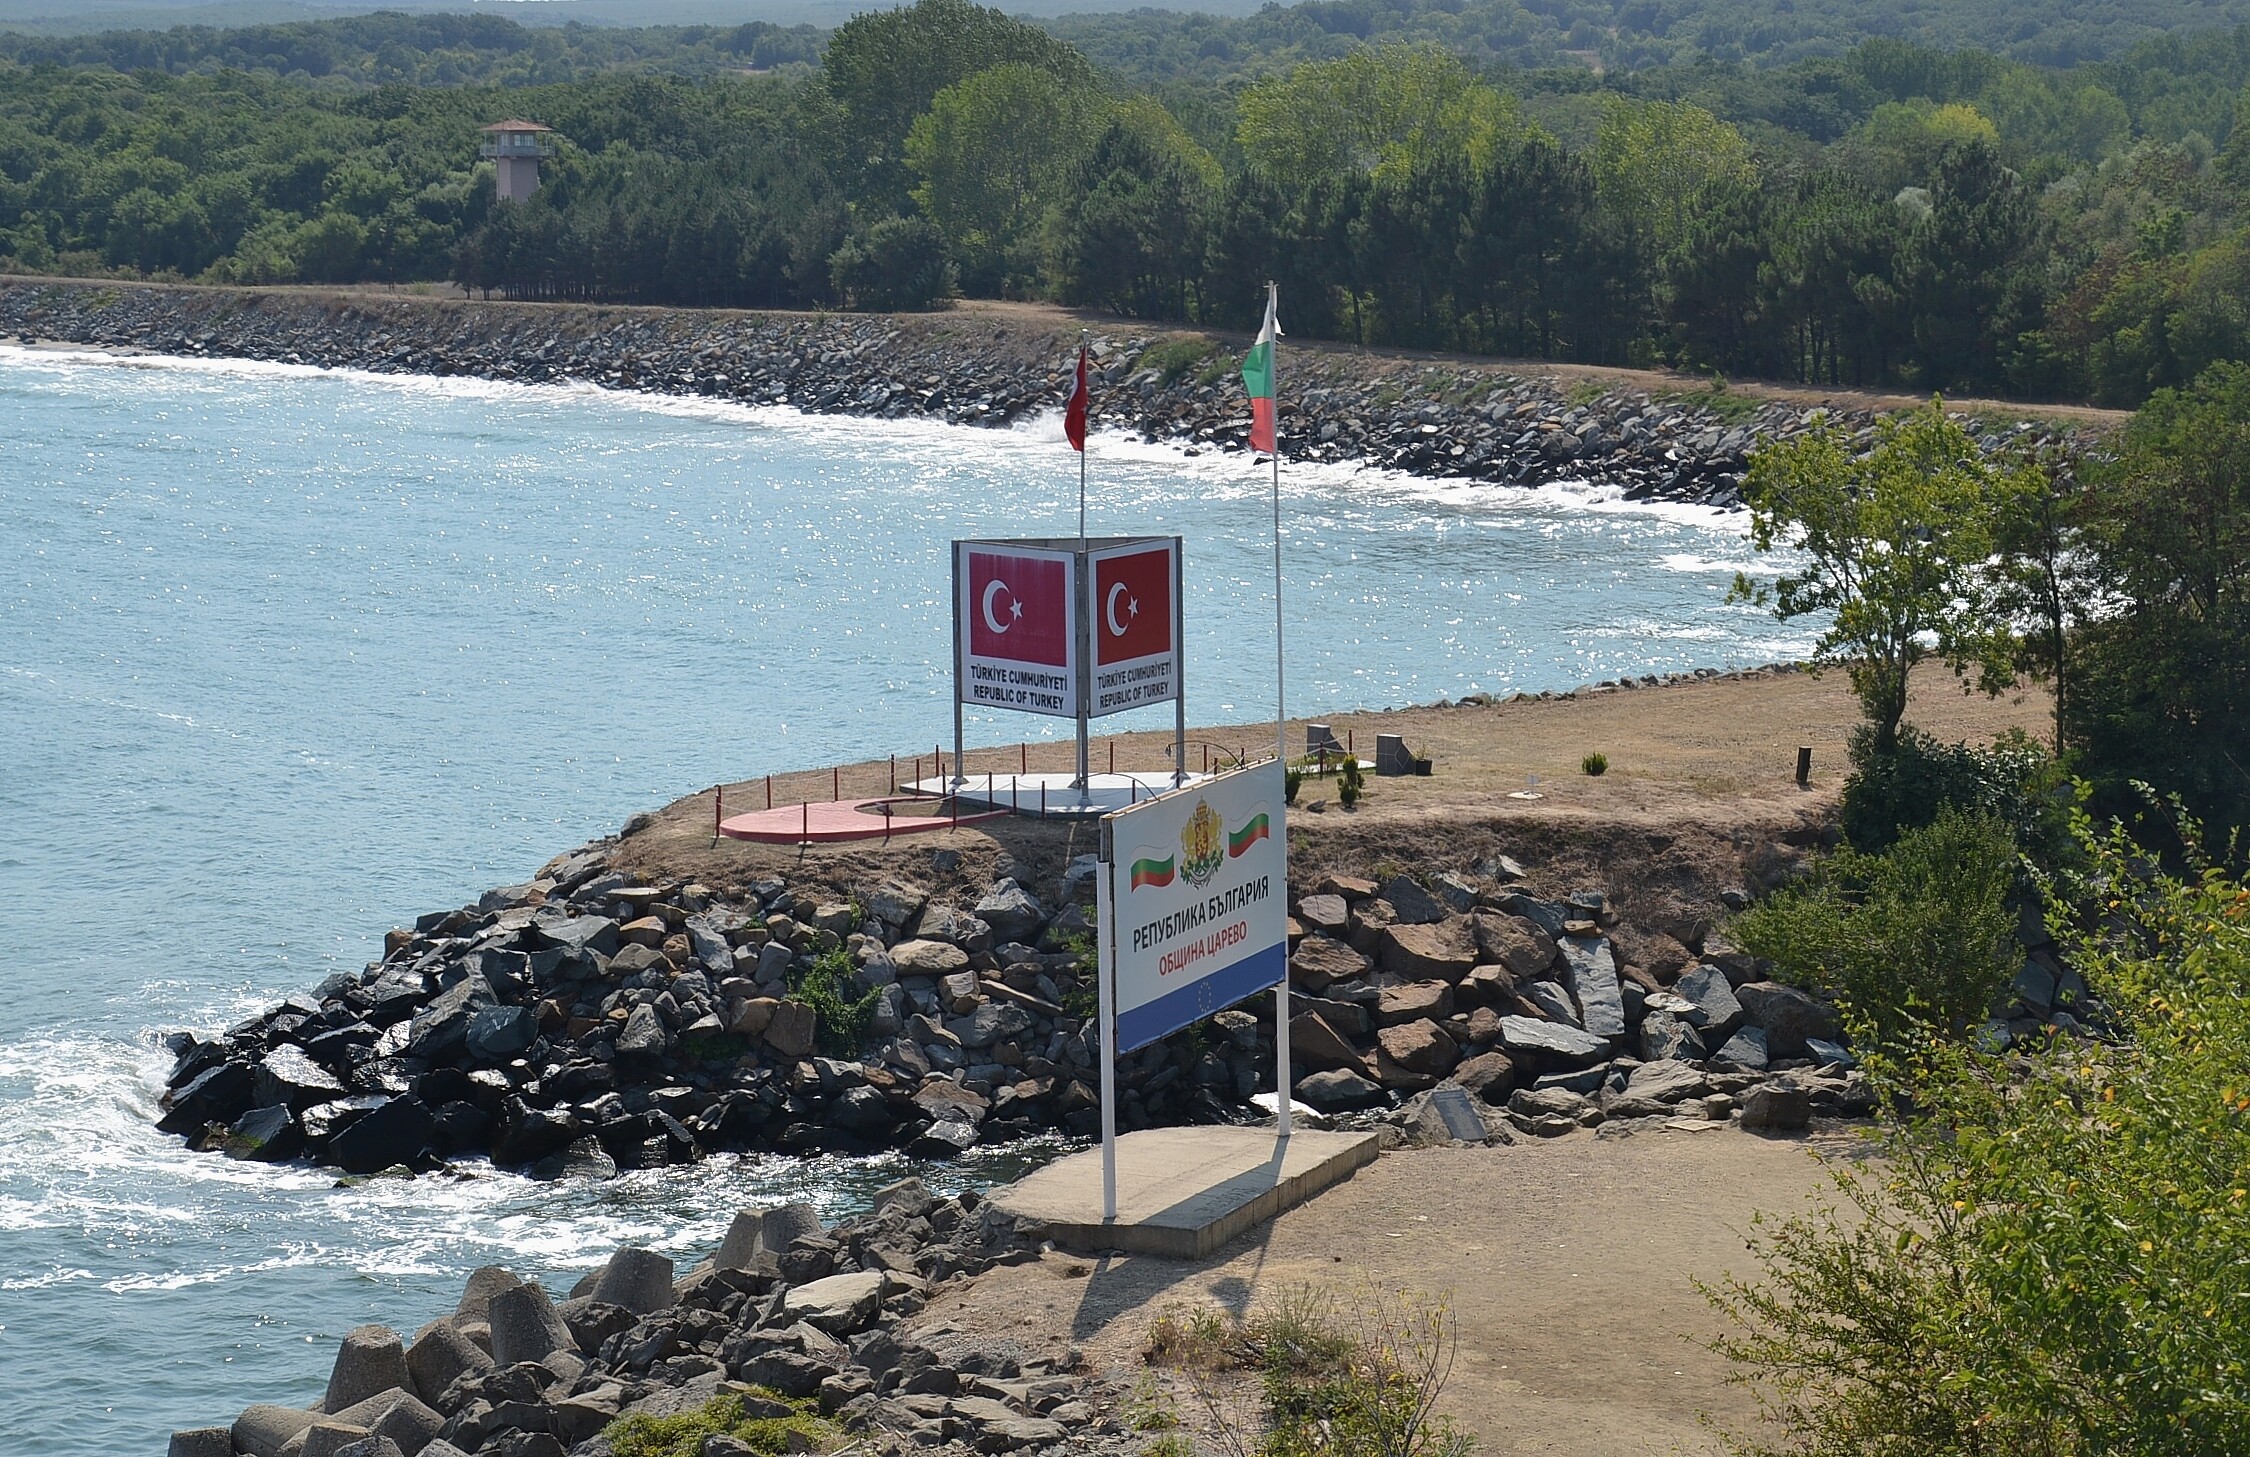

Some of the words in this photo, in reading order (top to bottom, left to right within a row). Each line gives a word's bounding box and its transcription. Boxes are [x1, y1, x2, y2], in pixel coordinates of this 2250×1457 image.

[970, 663, 1007, 683] TÜRKİYE
[1008, 670, 1068, 692] CUMHURİYETİ
[1097, 669, 1127, 690] TÜRKİYE
[1127, 658, 1172, 683] CUMHURİYETİ
[973, 684, 1014, 703] REPUBLIC
[1015, 689, 1028, 704] OF
[1029, 691, 1064, 710] TURKEY
[1099, 688, 1132, 709] REPUBLIC
[1132, 686, 1142, 701] OF
[1142, 681, 1169, 699] TURKEY
[1133, 902, 1206, 952] РЕПУБЛИКА
[1208, 875, 1269, 921] БЪЛГАРИЯ
[1159, 939, 1205, 976] ОБЩИНА
[1207, 920, 1248, 958] ЦАРЕВО
